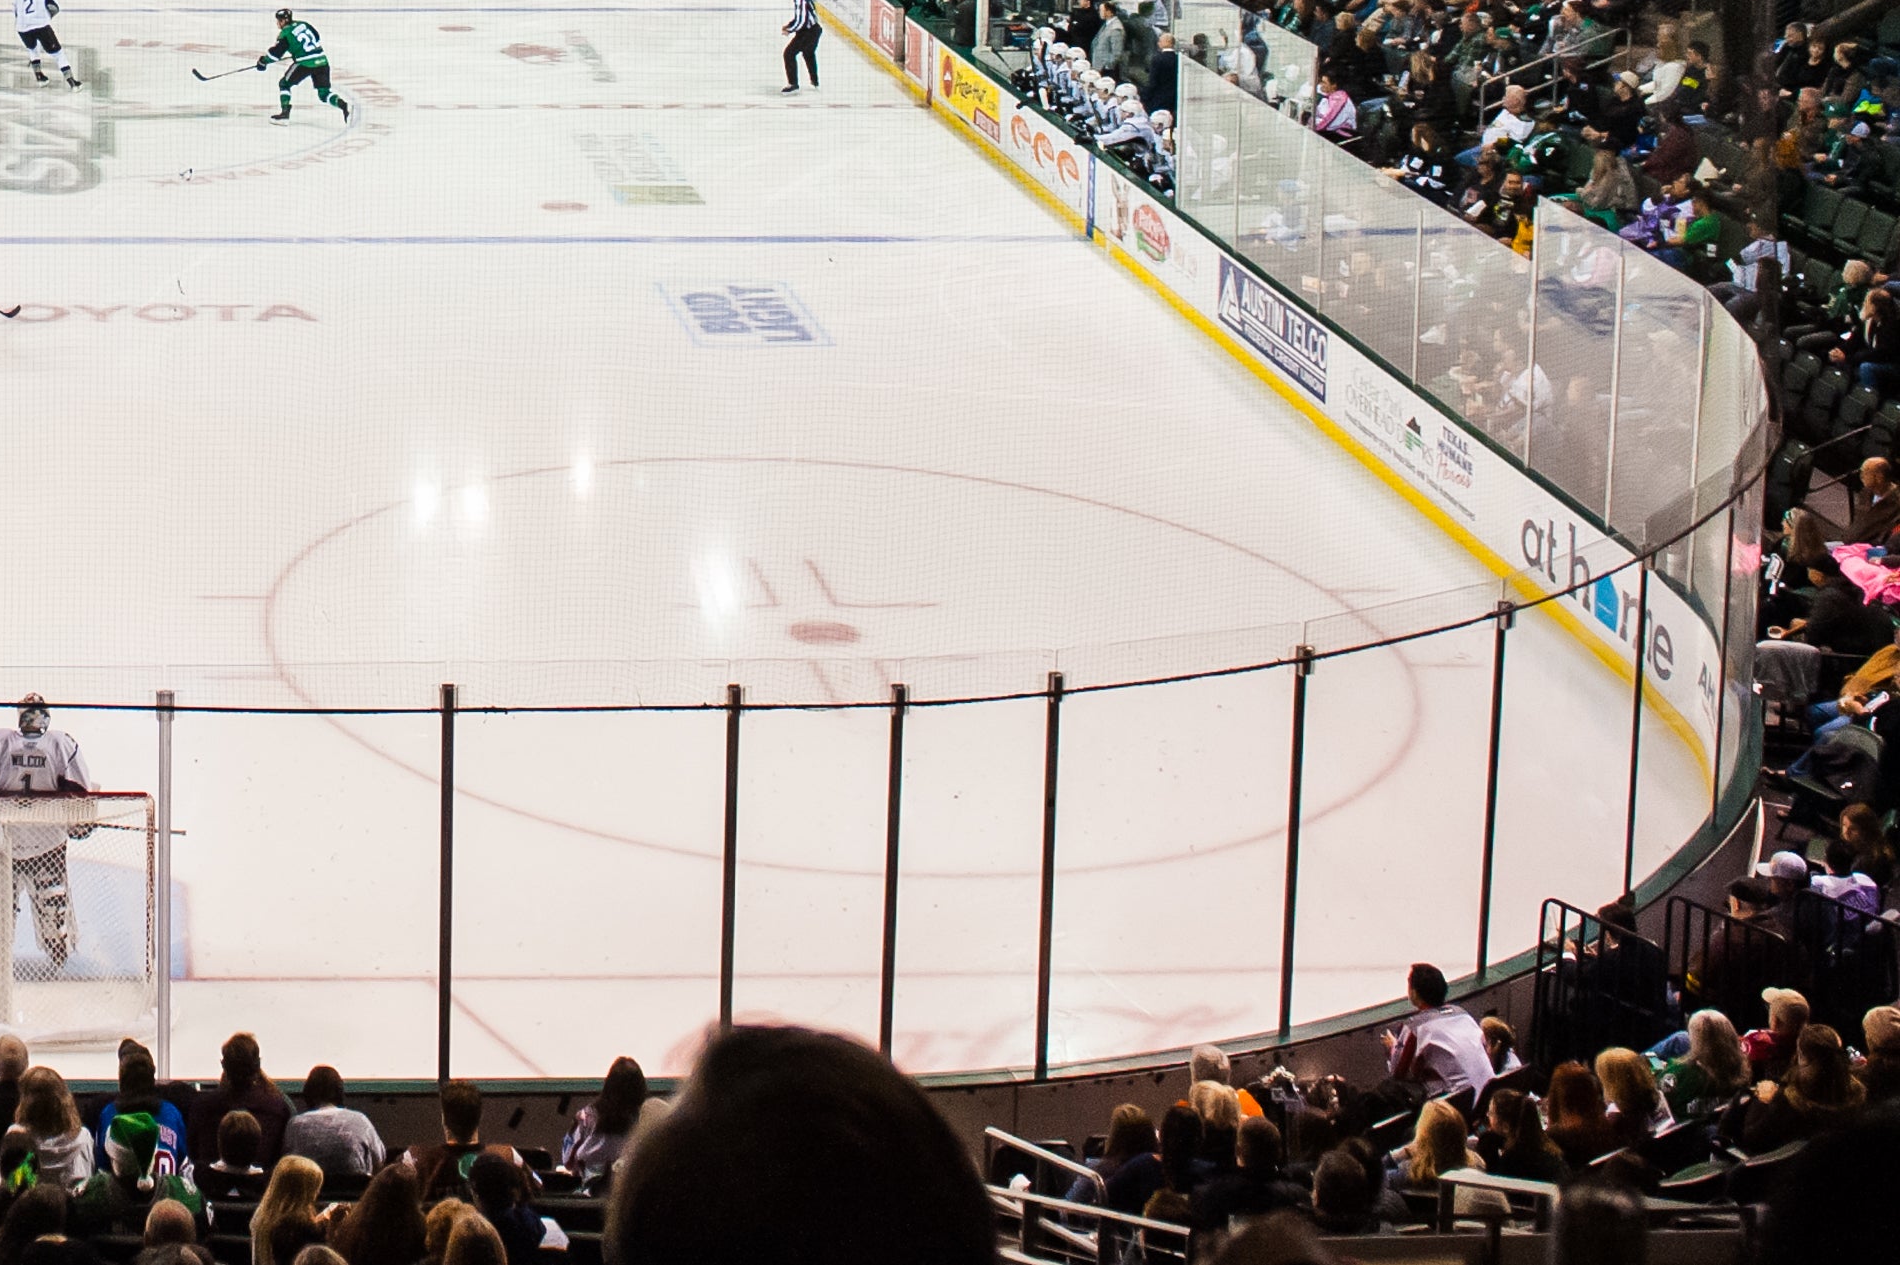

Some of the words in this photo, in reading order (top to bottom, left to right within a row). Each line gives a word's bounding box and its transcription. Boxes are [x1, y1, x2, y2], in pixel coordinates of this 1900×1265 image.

[1241, 277, 1285, 336] AUSTIN
[1286, 307, 1328, 370] TELCO
[1300, 364, 1324, 396] UNION
[1443, 425, 1469, 455] TEXAS
[1438, 438, 1473, 476] HUMANE
[1521, 518, 1556, 583] at
[11, 753, 47, 769] WILCOX
[19, 773, 32, 792] 1
